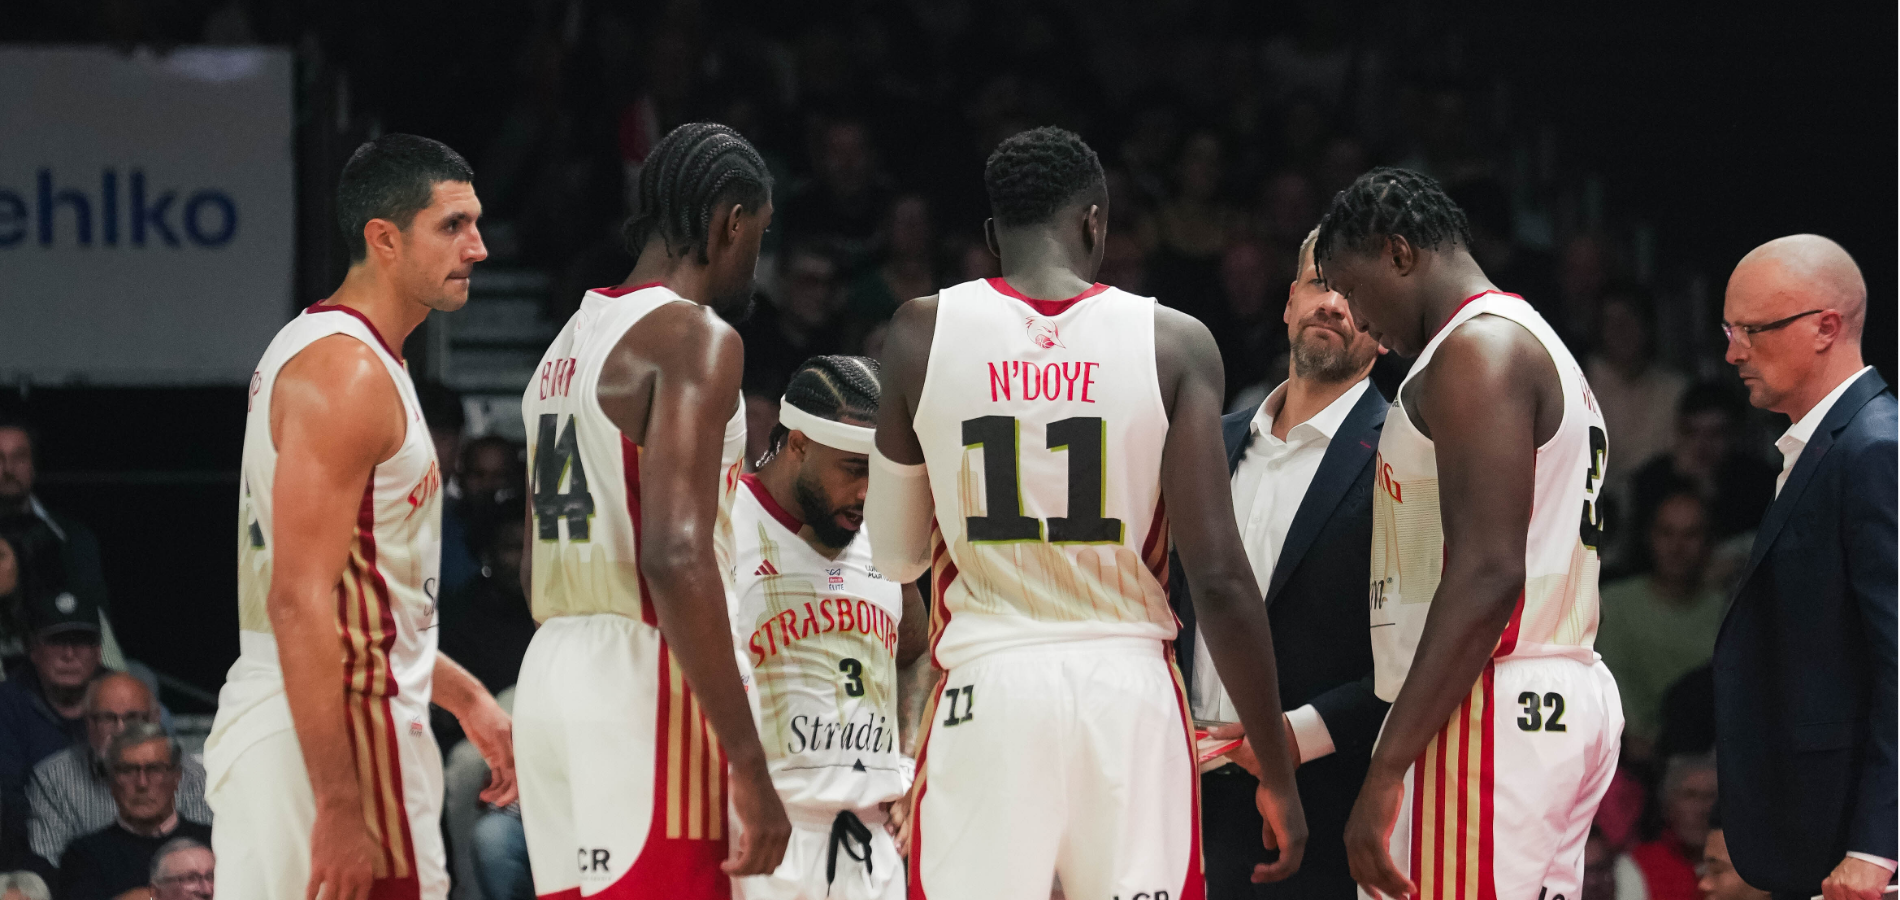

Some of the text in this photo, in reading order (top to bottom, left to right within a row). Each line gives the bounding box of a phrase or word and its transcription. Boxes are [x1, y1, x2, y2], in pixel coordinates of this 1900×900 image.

[987, 361, 1100, 404] N'DOYE
[961, 415, 1127, 546] 11
[748, 598, 897, 669] STRASBOUR
[838, 657, 865, 698] 3
[943, 684, 975, 727] 11
[1516, 691, 1567, 733] 32
